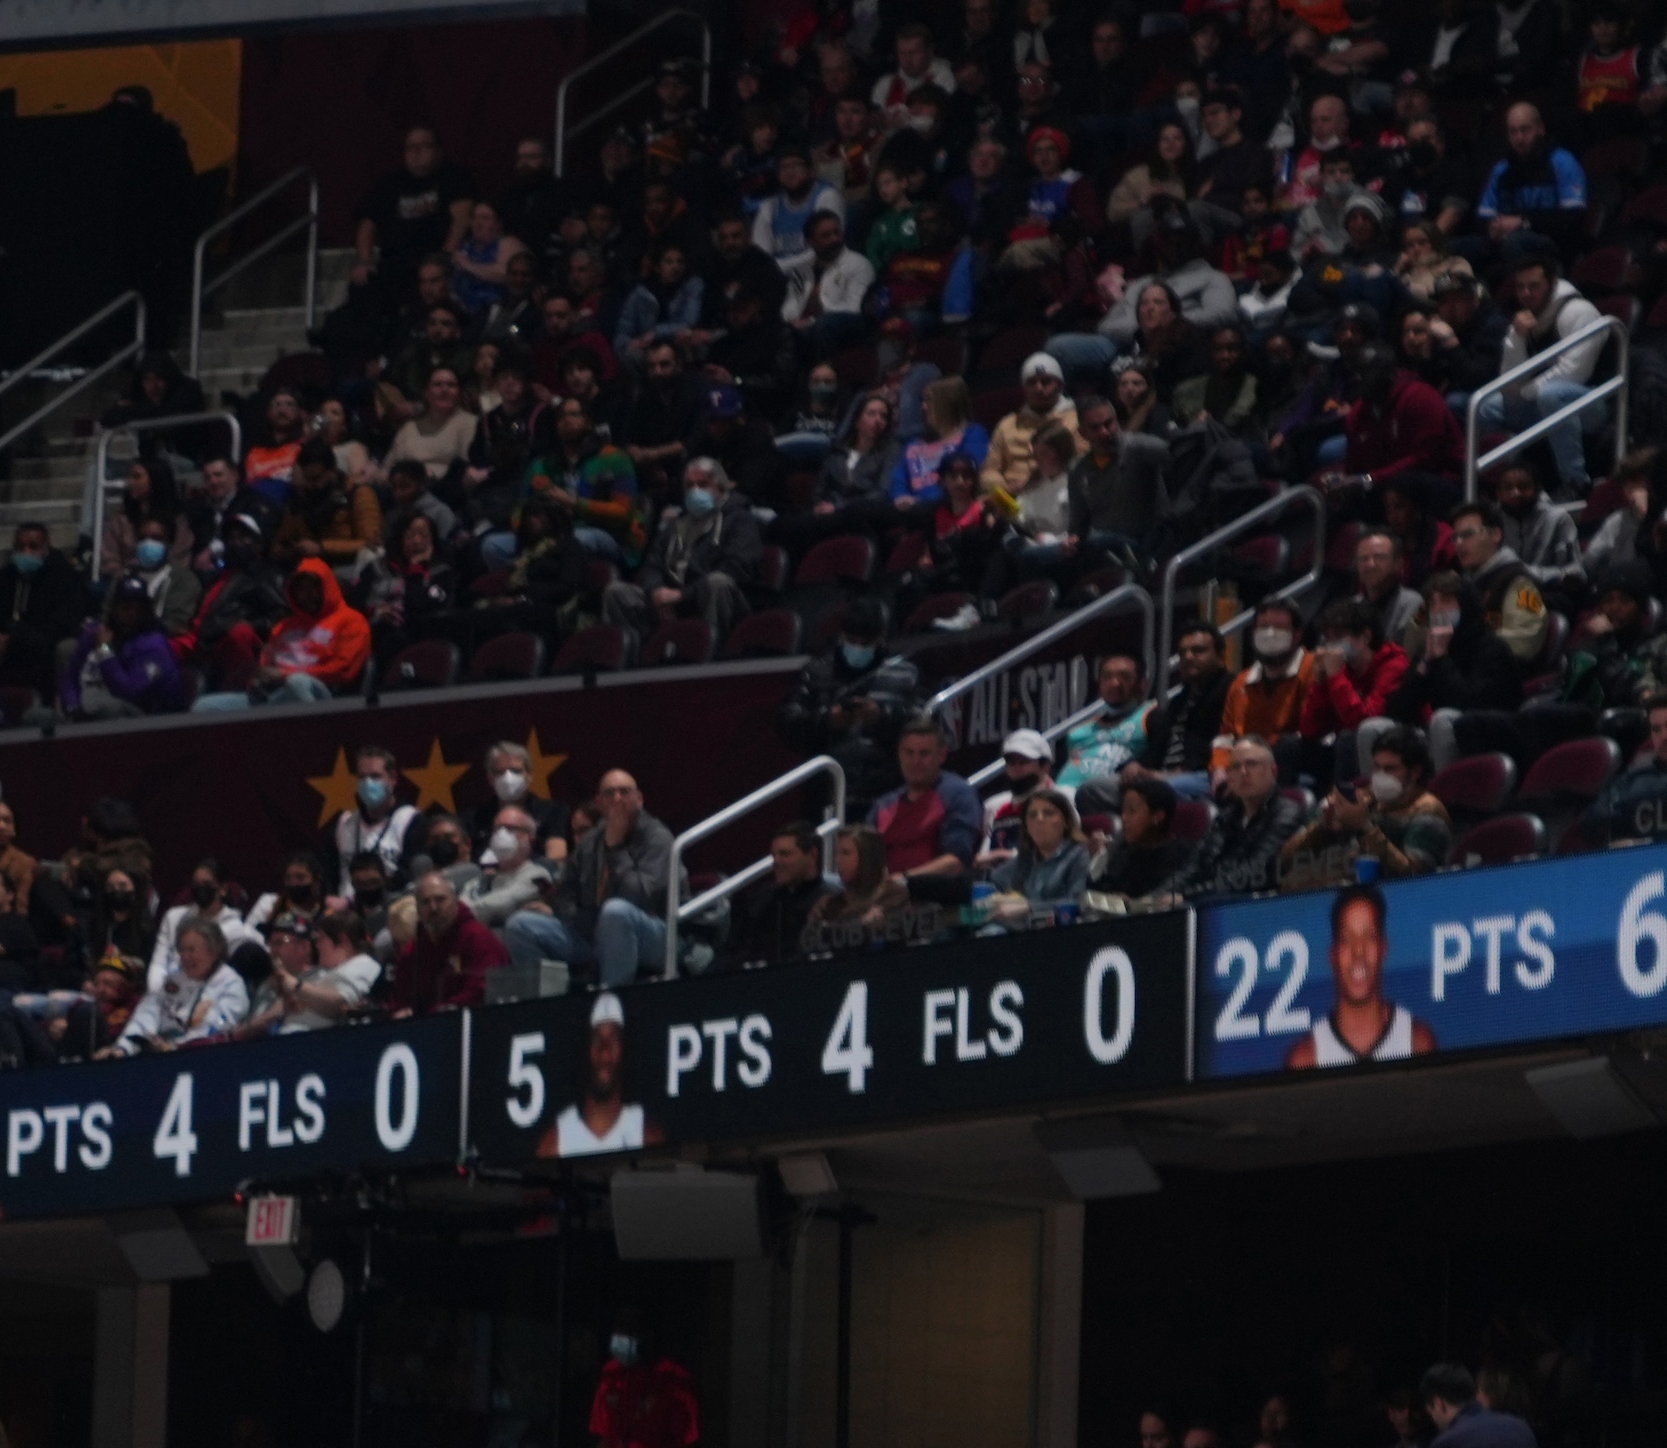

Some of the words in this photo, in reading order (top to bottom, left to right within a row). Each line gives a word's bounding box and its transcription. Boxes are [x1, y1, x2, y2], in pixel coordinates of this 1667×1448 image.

[506, 1031, 547, 1128] 5
[667, 1014, 772, 1098] PTS
[821, 979, 873, 1094] 4
[923, 980, 1025, 1065] FLS
[1083, 944, 1135, 1064] 0
[1215, 930, 1310, 1041] 22
[1432, 908, 1555, 1001] PTS
[1618, 870, 1667, 999] 6
[7, 1102, 113, 1177] PTS
[153, 1073, 197, 1176] 4
[239, 1073, 326, 1151] FLS
[375, 1042, 420, 1151] 0
